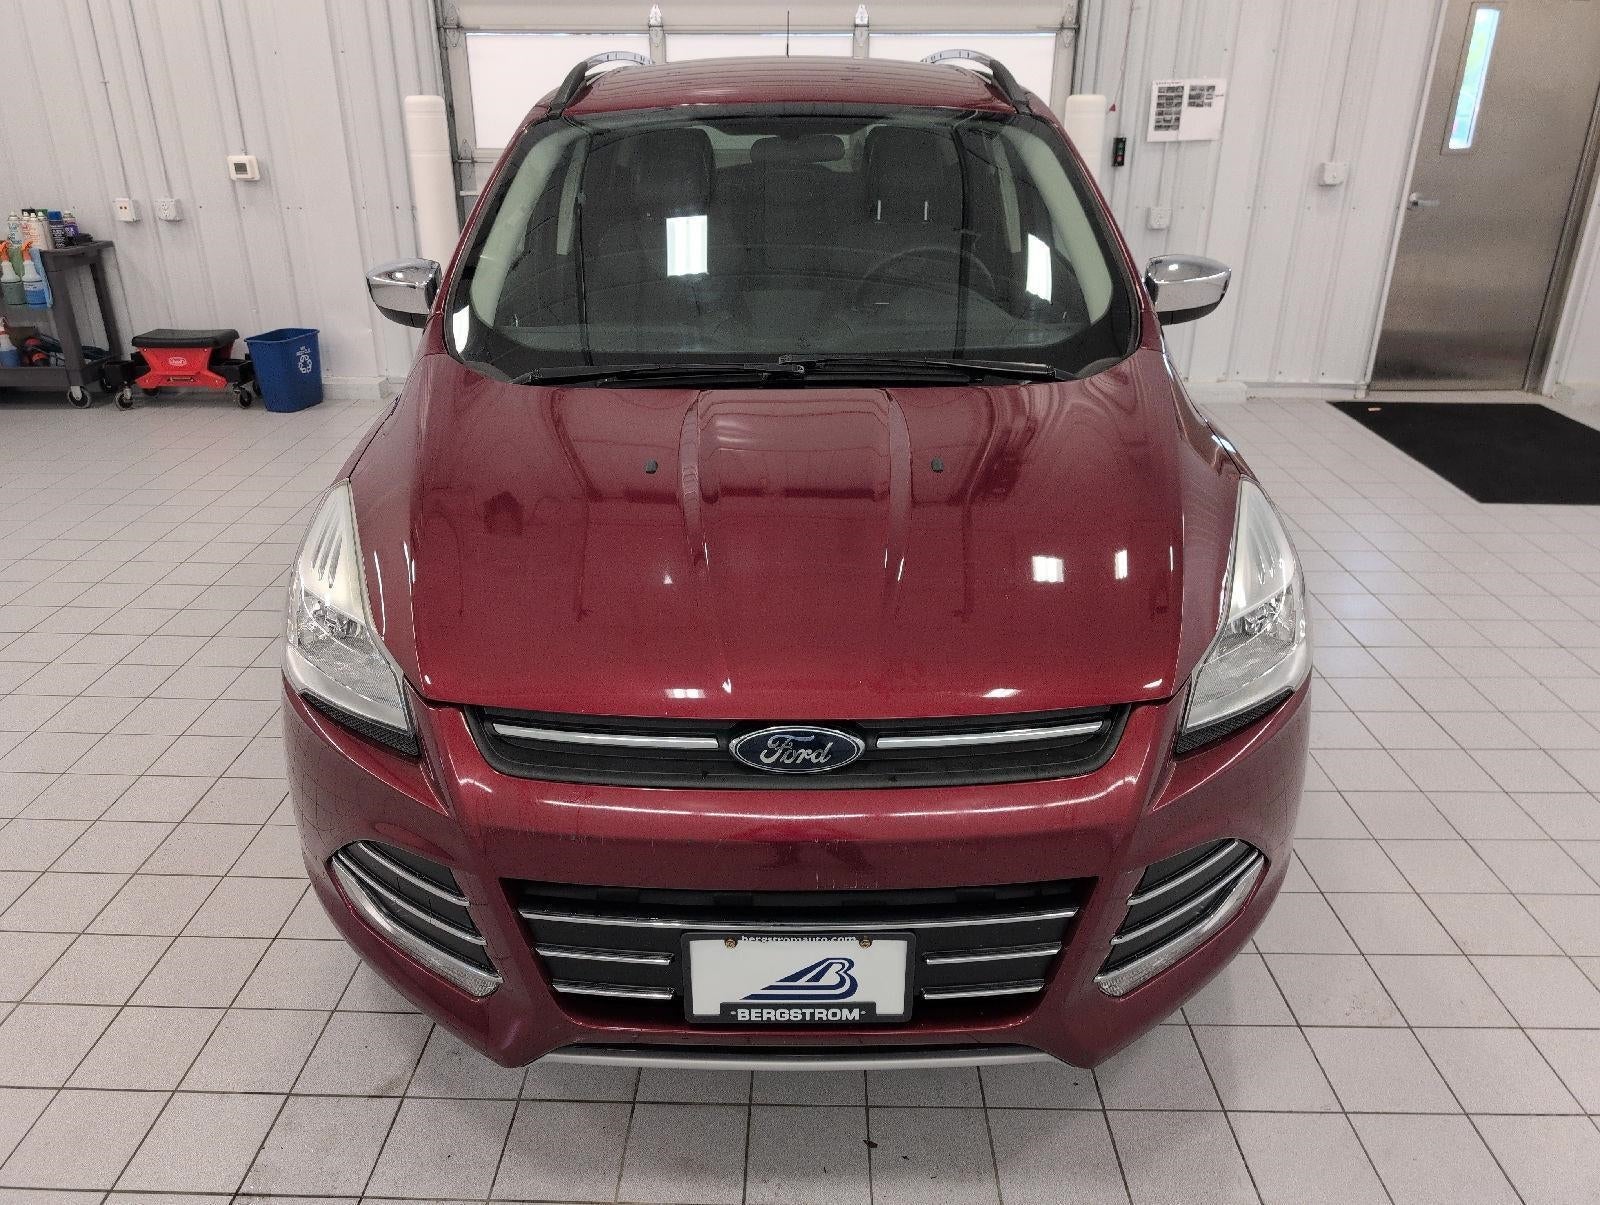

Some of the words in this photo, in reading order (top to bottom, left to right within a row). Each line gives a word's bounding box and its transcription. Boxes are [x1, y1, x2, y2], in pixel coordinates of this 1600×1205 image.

[760, 735, 834, 764] Ford
[741, 935, 857, 943] bergstromauto.com
[737, 1008, 860, 1021] BERGSTROM
